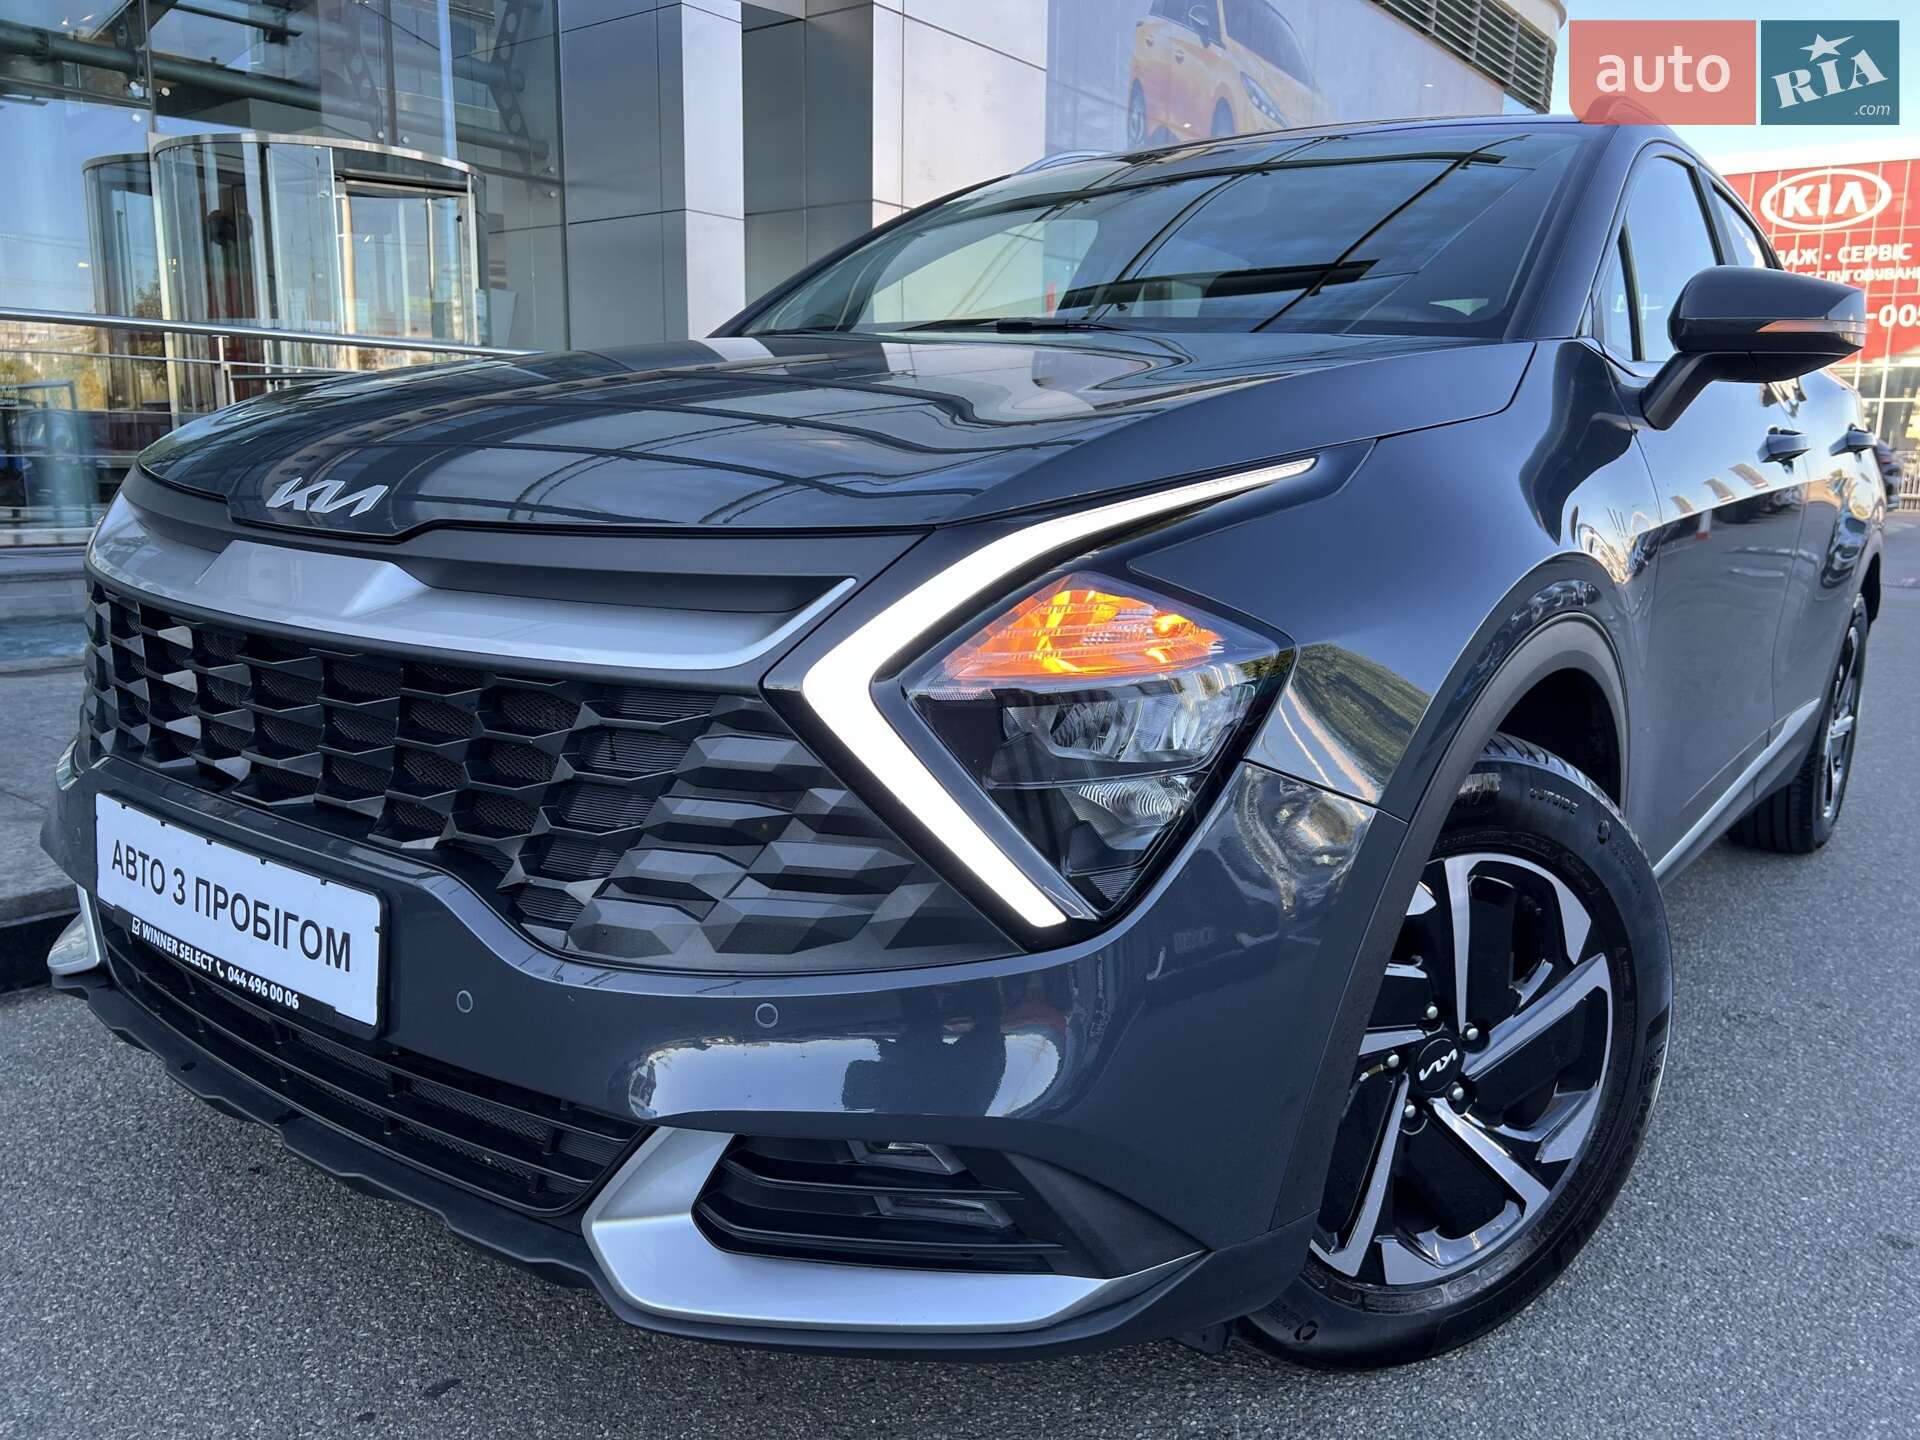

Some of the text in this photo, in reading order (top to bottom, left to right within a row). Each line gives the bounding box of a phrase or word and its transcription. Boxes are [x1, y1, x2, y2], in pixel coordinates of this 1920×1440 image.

[1782, 181, 1868, 218] KIA
[1837, 243, 1913, 264] СЕРВІС
[265, 477, 388, 517] KIA
[112, 840, 350, 972] АВТО З ПРОБІГОМ
[142, 922, 300, 1010] WINNER SELECT 044 496 00 06
